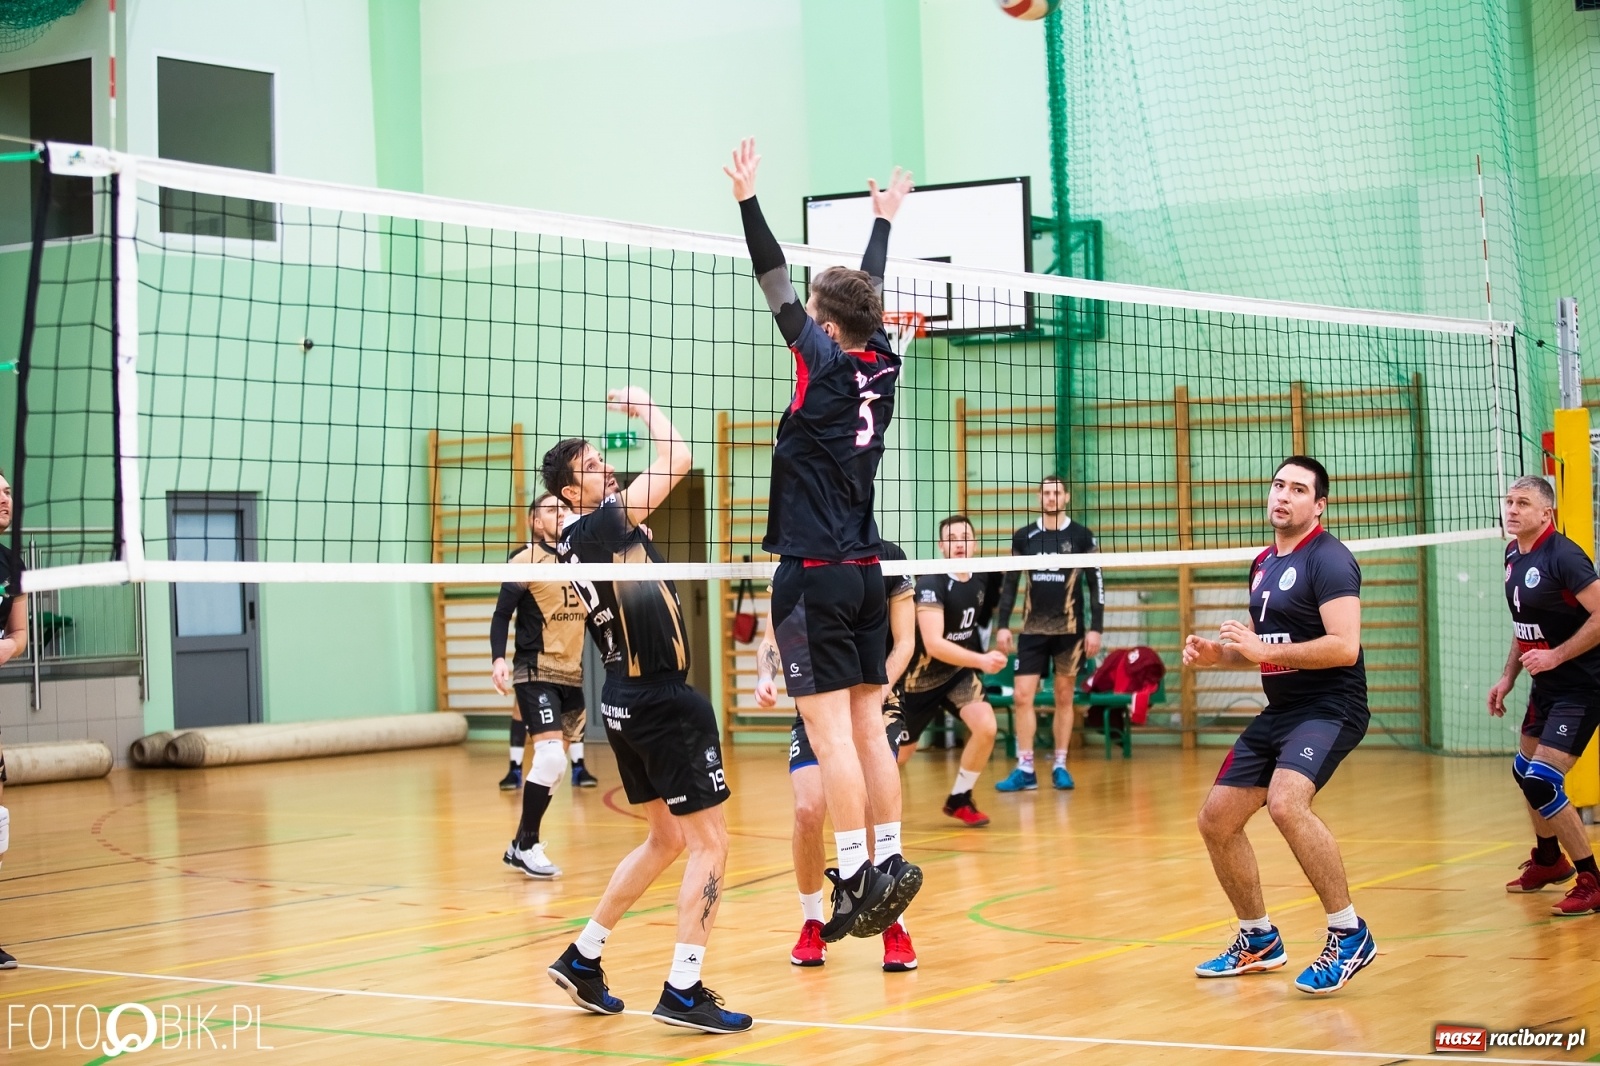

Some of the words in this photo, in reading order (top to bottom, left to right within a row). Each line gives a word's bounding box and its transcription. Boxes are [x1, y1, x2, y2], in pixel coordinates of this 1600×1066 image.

[1260, 591, 1270, 622] 7
[1513, 585, 1520, 613] 4
[960, 607, 975, 629] 10
[539, 709, 554, 724] 13
[601, 702, 631, 719] OLLEYBALL
[607, 717, 622, 732] TEAM
[709, 769, 726, 792] 19
